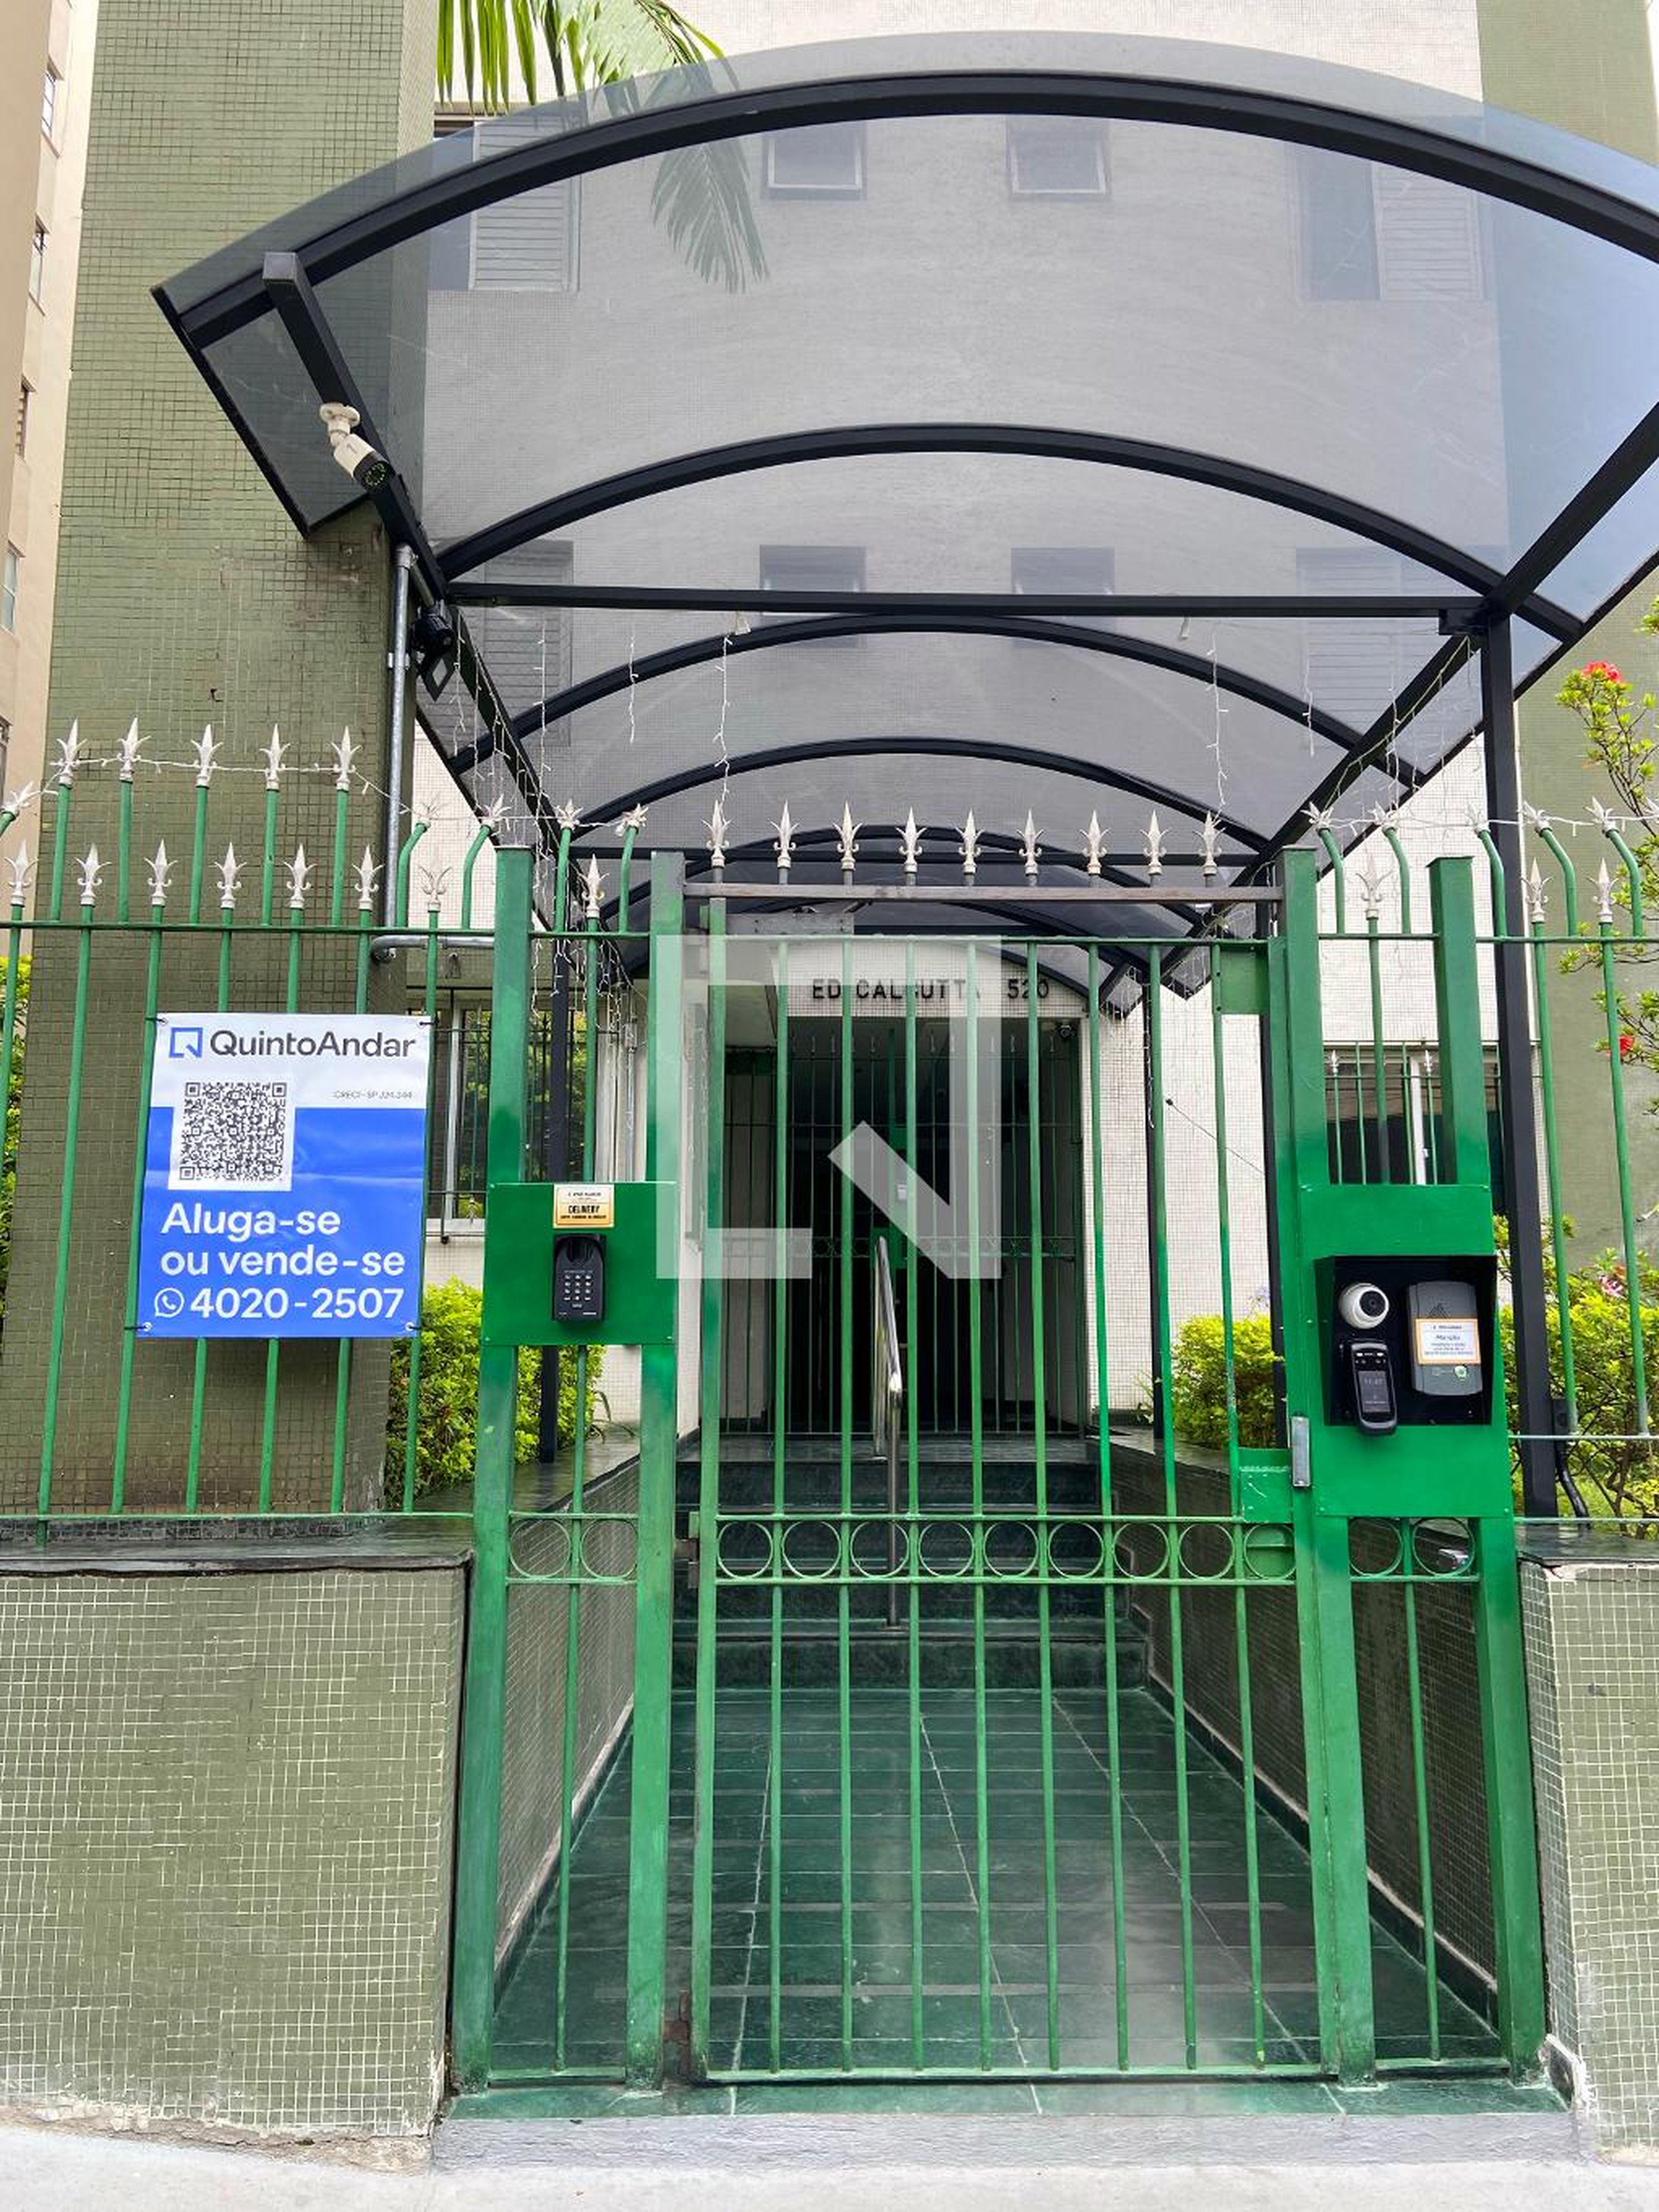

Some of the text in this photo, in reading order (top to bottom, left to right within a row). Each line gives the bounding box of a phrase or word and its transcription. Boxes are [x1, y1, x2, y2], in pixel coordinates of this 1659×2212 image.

[857, 978, 980, 999] CALUTT
[1007, 978, 1049, 999] 520
[210, 1030, 416, 1057] QuintoAndar
[160, 1202, 341, 1242] Aluga-se
[160, 1244, 405, 1276] ou vende-se
[190, 1287, 404, 1319] 4020-2507
